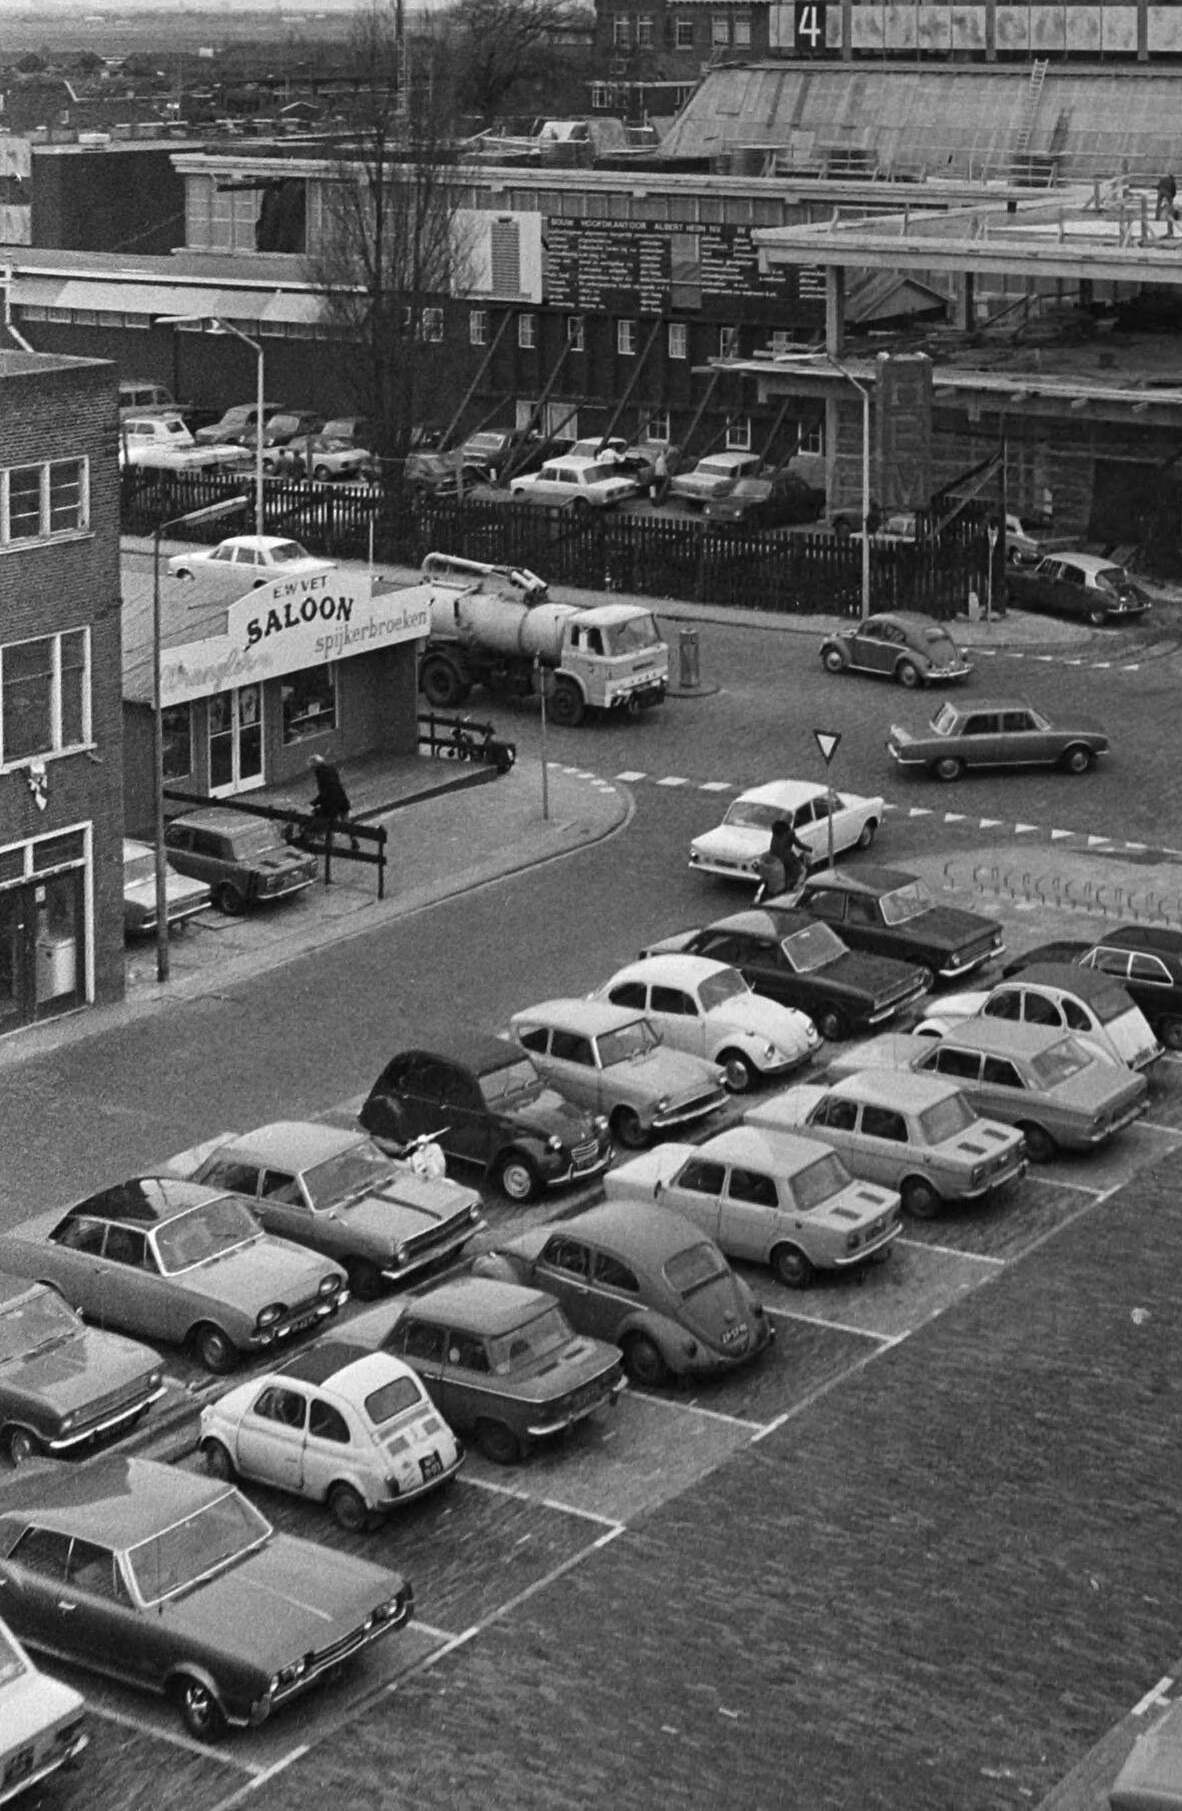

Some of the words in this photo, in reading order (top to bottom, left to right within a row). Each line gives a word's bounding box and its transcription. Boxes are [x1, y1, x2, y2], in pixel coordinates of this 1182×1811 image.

[799, 6, 821, 47] 4
[301, 575, 328, 592] VET
[246, 596, 354, 645] SALOON
[315, 609, 427, 659] spijkerbroeken
